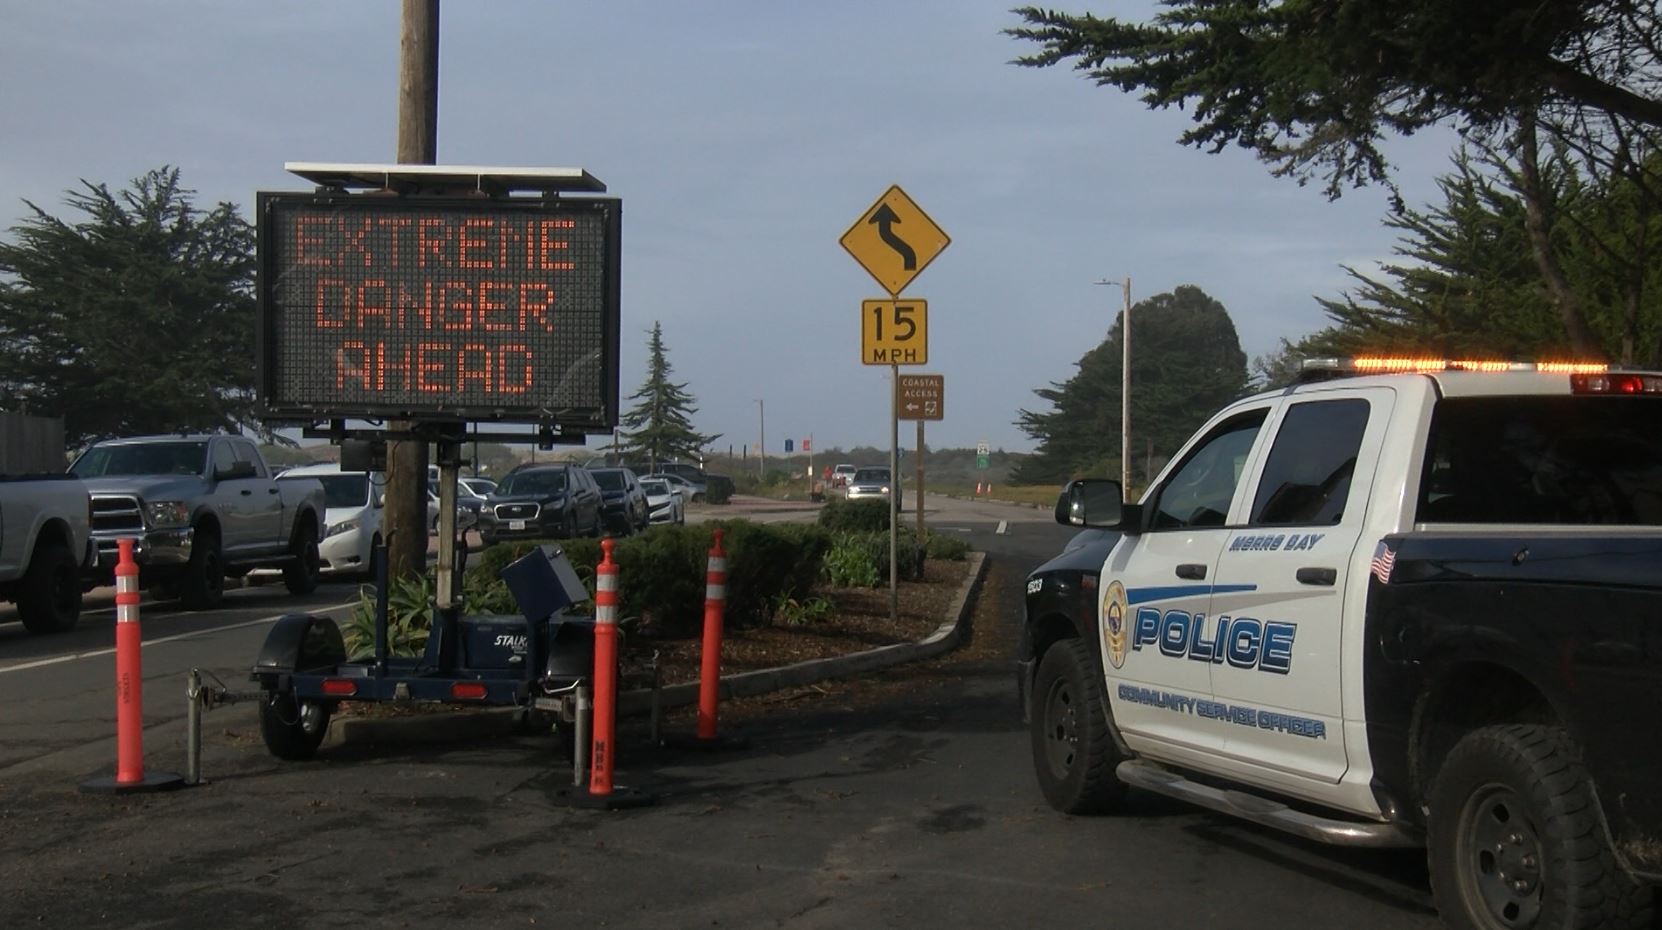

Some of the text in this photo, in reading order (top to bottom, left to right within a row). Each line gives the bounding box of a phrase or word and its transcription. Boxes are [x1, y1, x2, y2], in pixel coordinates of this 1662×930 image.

[296, 216, 576, 270] EXTREME
[316, 278, 555, 332] DANGER
[873, 307, 916, 341] 15
[336, 340, 533, 393] AHEAD
[873, 349, 916, 362] MPH
[1228, 533, 1326, 552] MORRO BAY
[494, 635, 528, 647] STALK
[1132, 606, 1298, 675] POLICE
[1118, 683, 1327, 740] COMMUNITY SERVICE OFFICER
